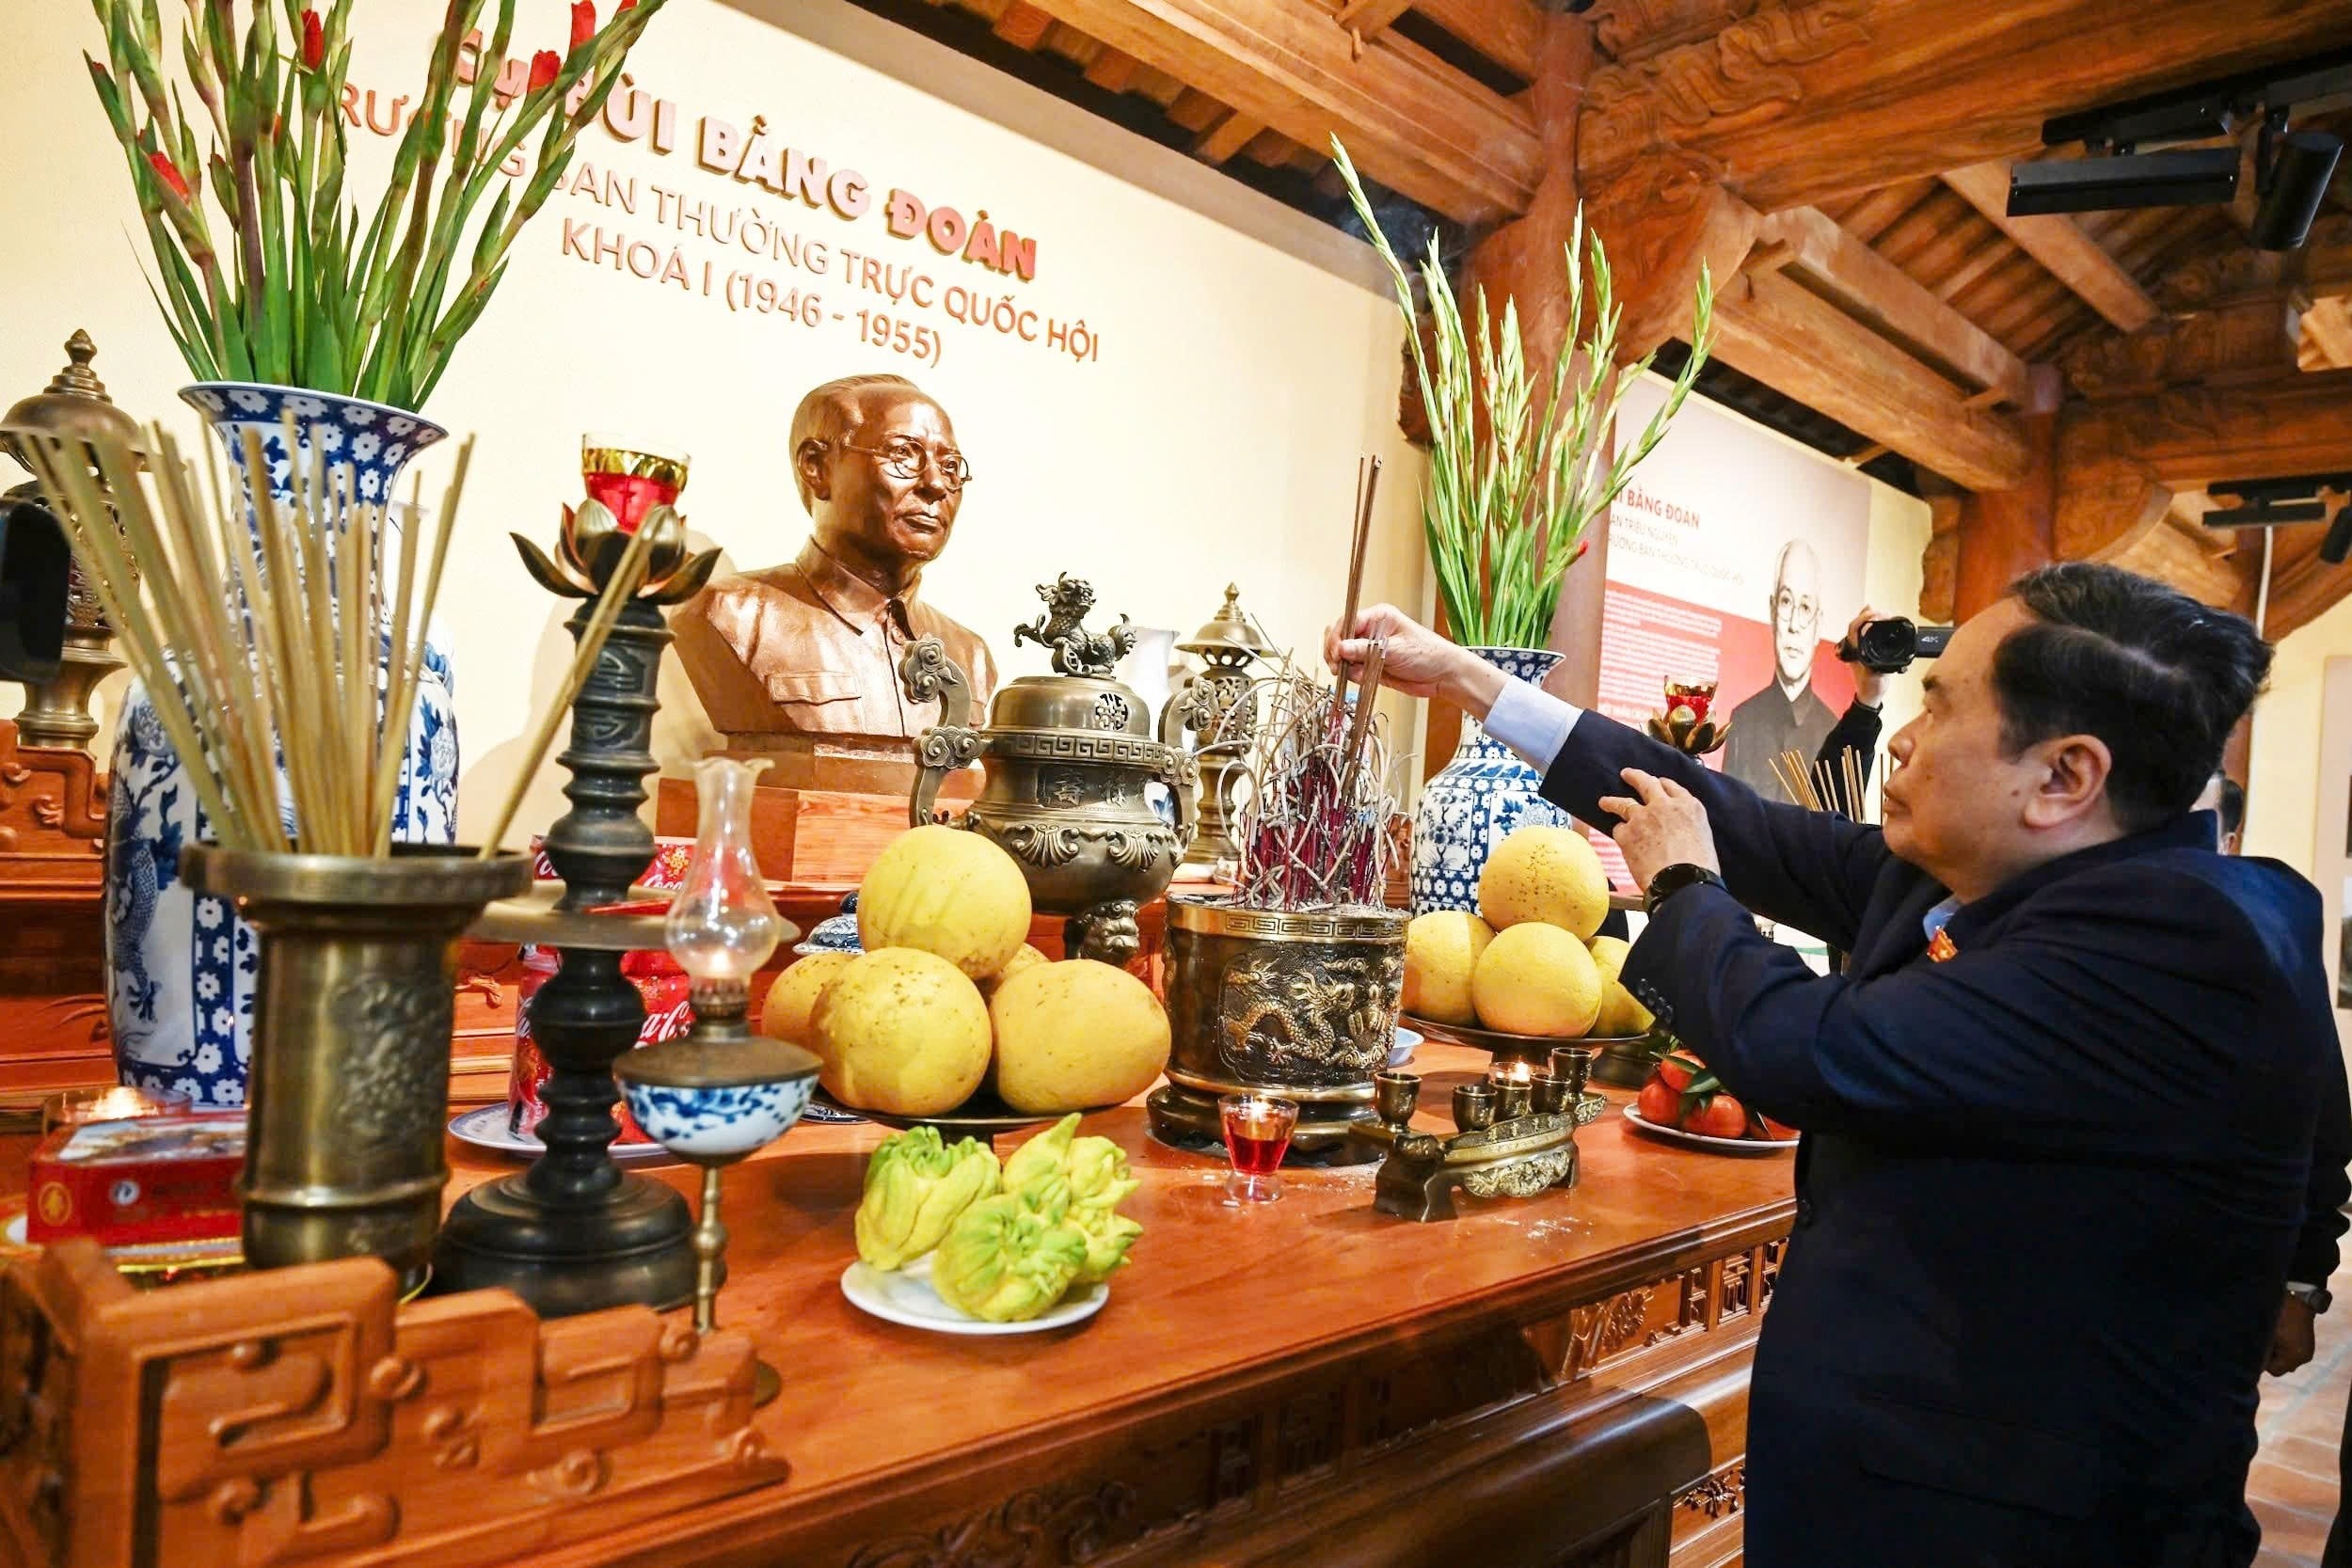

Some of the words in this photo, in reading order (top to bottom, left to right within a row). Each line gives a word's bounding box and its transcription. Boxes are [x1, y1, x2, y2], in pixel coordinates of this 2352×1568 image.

[651, 183, 830, 275] THƯỜNG
[839, 247, 934, 309] TRỰC
[944, 286, 1039, 342] QUỐC
[1046, 318, 1099, 363] HỘI
[697, 114, 871, 221] BẰNG
[885, 187, 1037, 283] ĐOÀN
[563, 217, 691, 291] KHOÁ
[703, 261, 713, 296] I
[725, 270, 823, 328] (1946
[856, 309, 942, 369] 1955)
